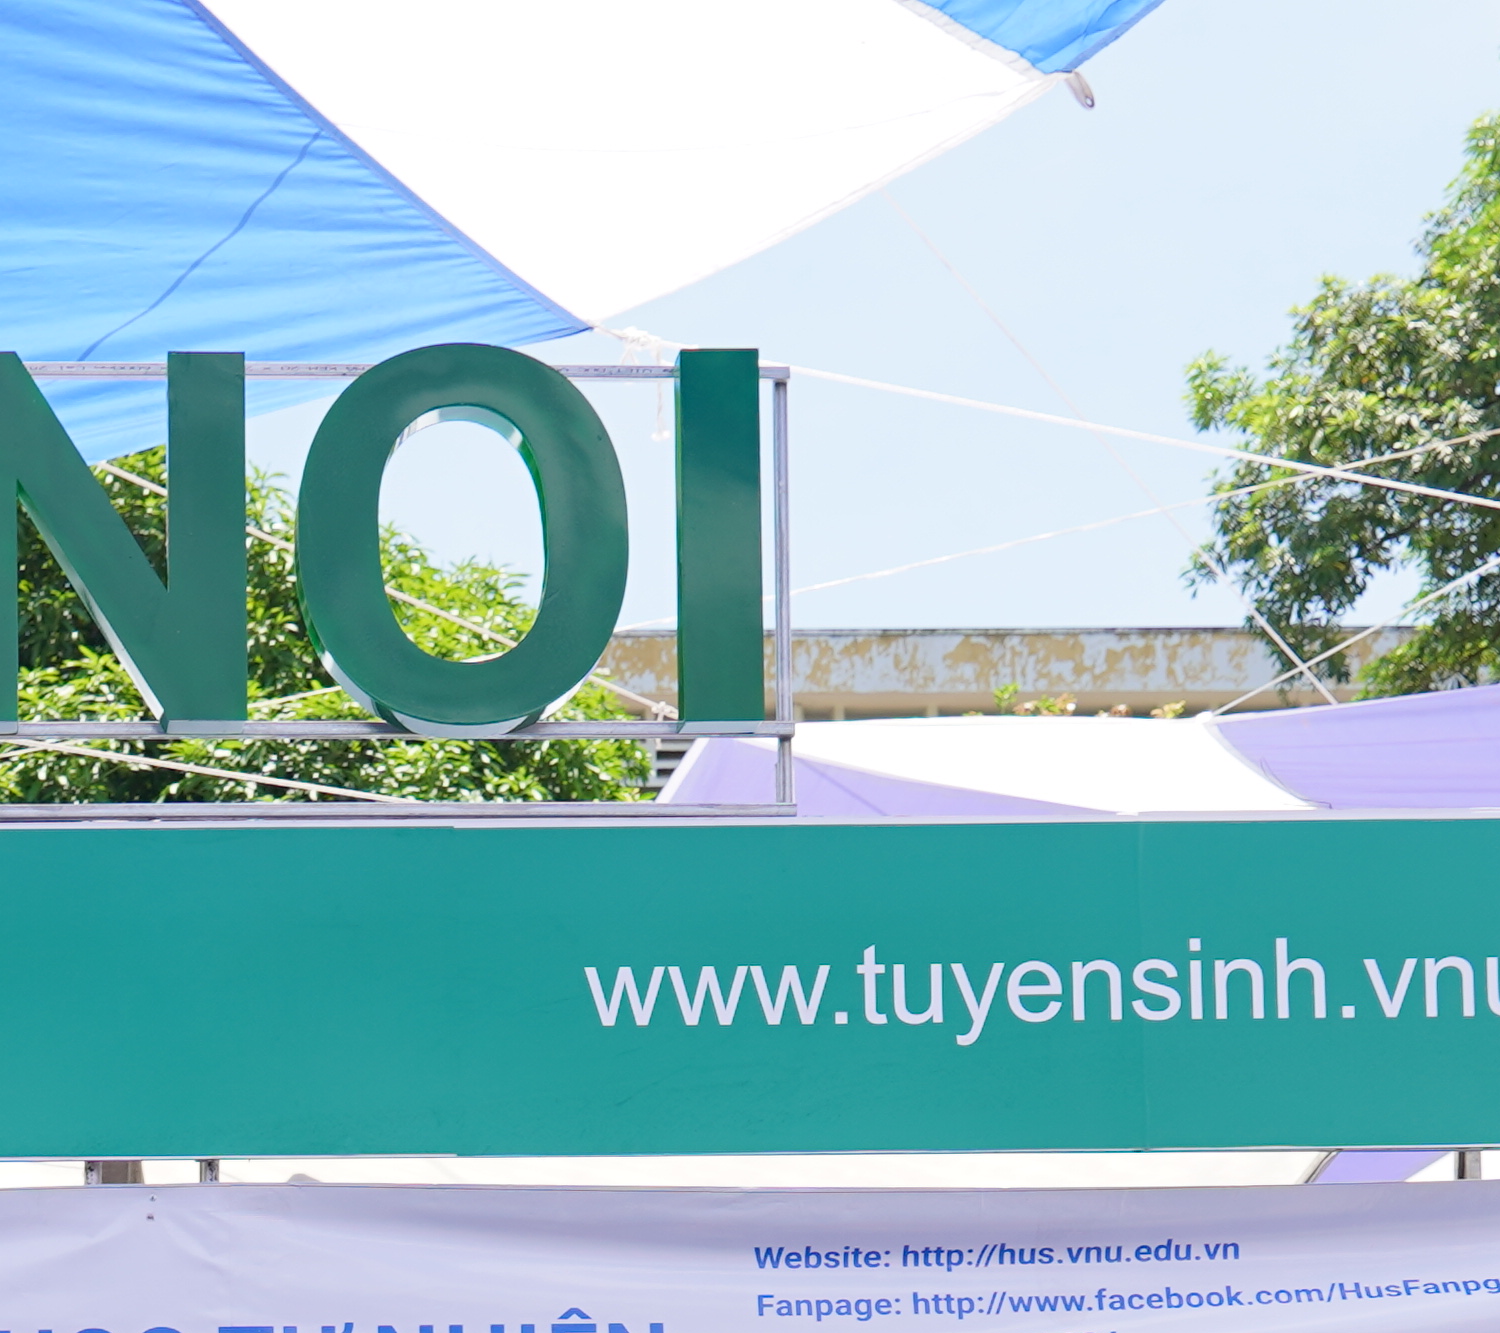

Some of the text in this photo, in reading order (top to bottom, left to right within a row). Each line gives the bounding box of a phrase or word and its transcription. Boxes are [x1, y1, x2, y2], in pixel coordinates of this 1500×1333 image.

[754, 1235, 1240, 1272] Website: http://hus.vnu.edu.vn
[757, 1293, 901, 1327] Fanpage:
